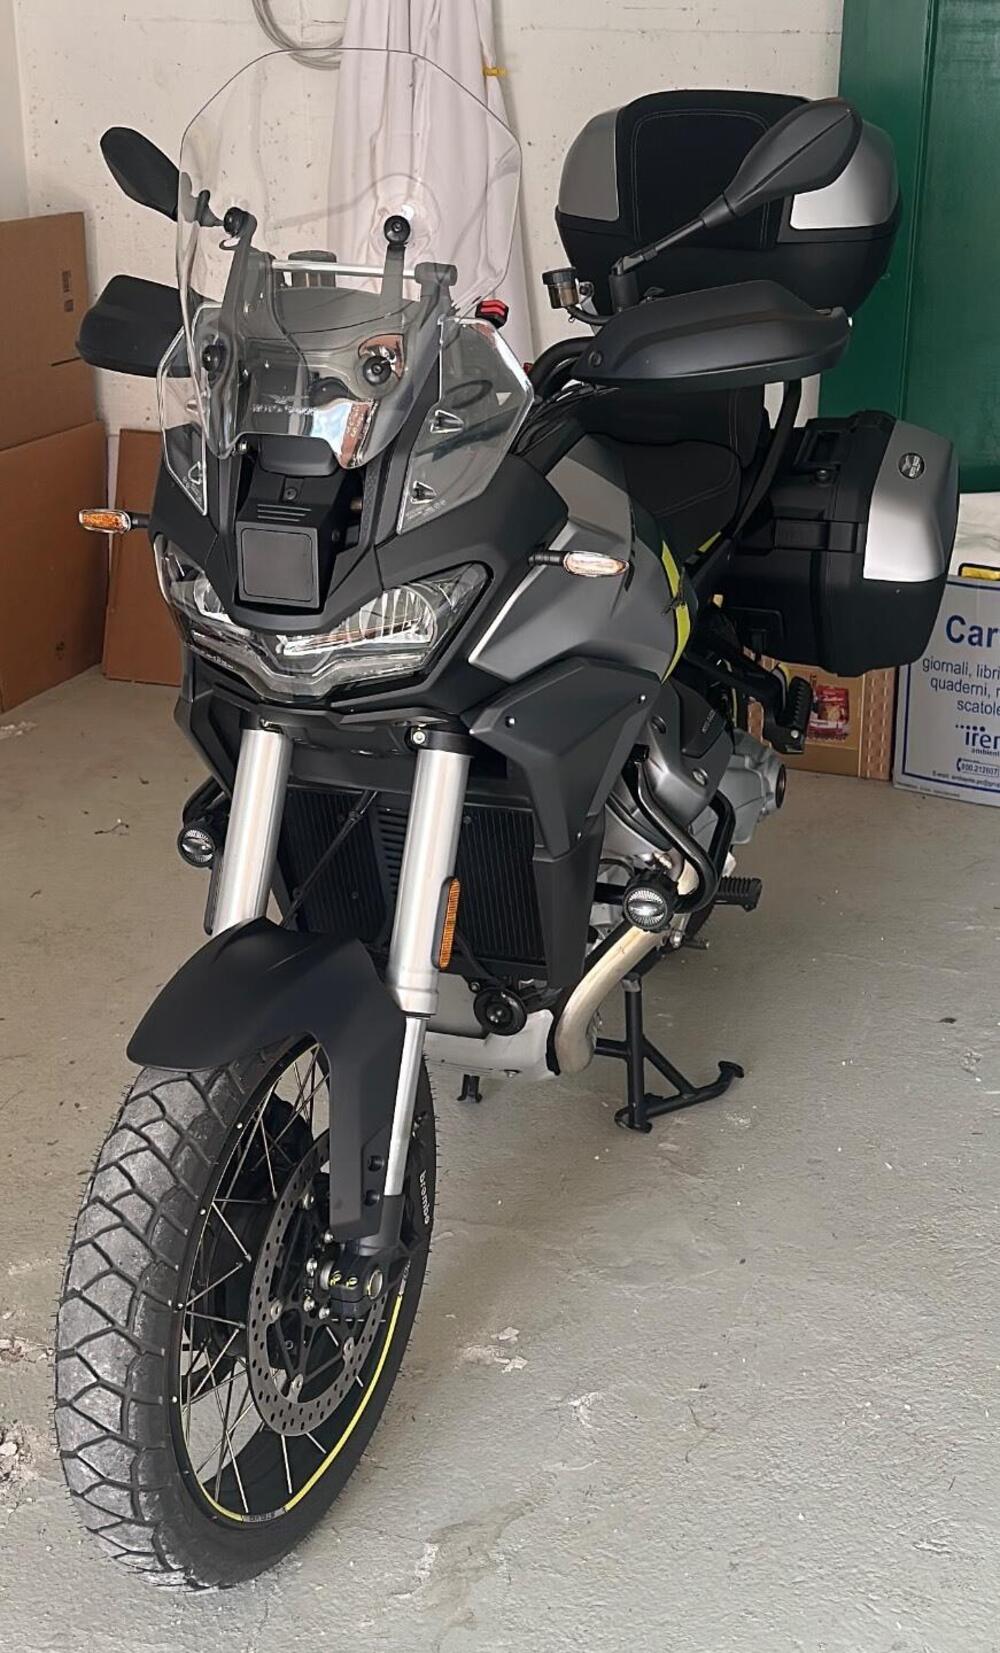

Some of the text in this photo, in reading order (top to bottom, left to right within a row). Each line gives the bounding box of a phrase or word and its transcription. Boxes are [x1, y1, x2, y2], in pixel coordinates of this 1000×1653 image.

[946, 615, 1000, 648] Car
[922, 656, 972, 678] giornali,
[930, 677, 991, 698] quaderni,
[419, 1169, 431, 1225] brembo
